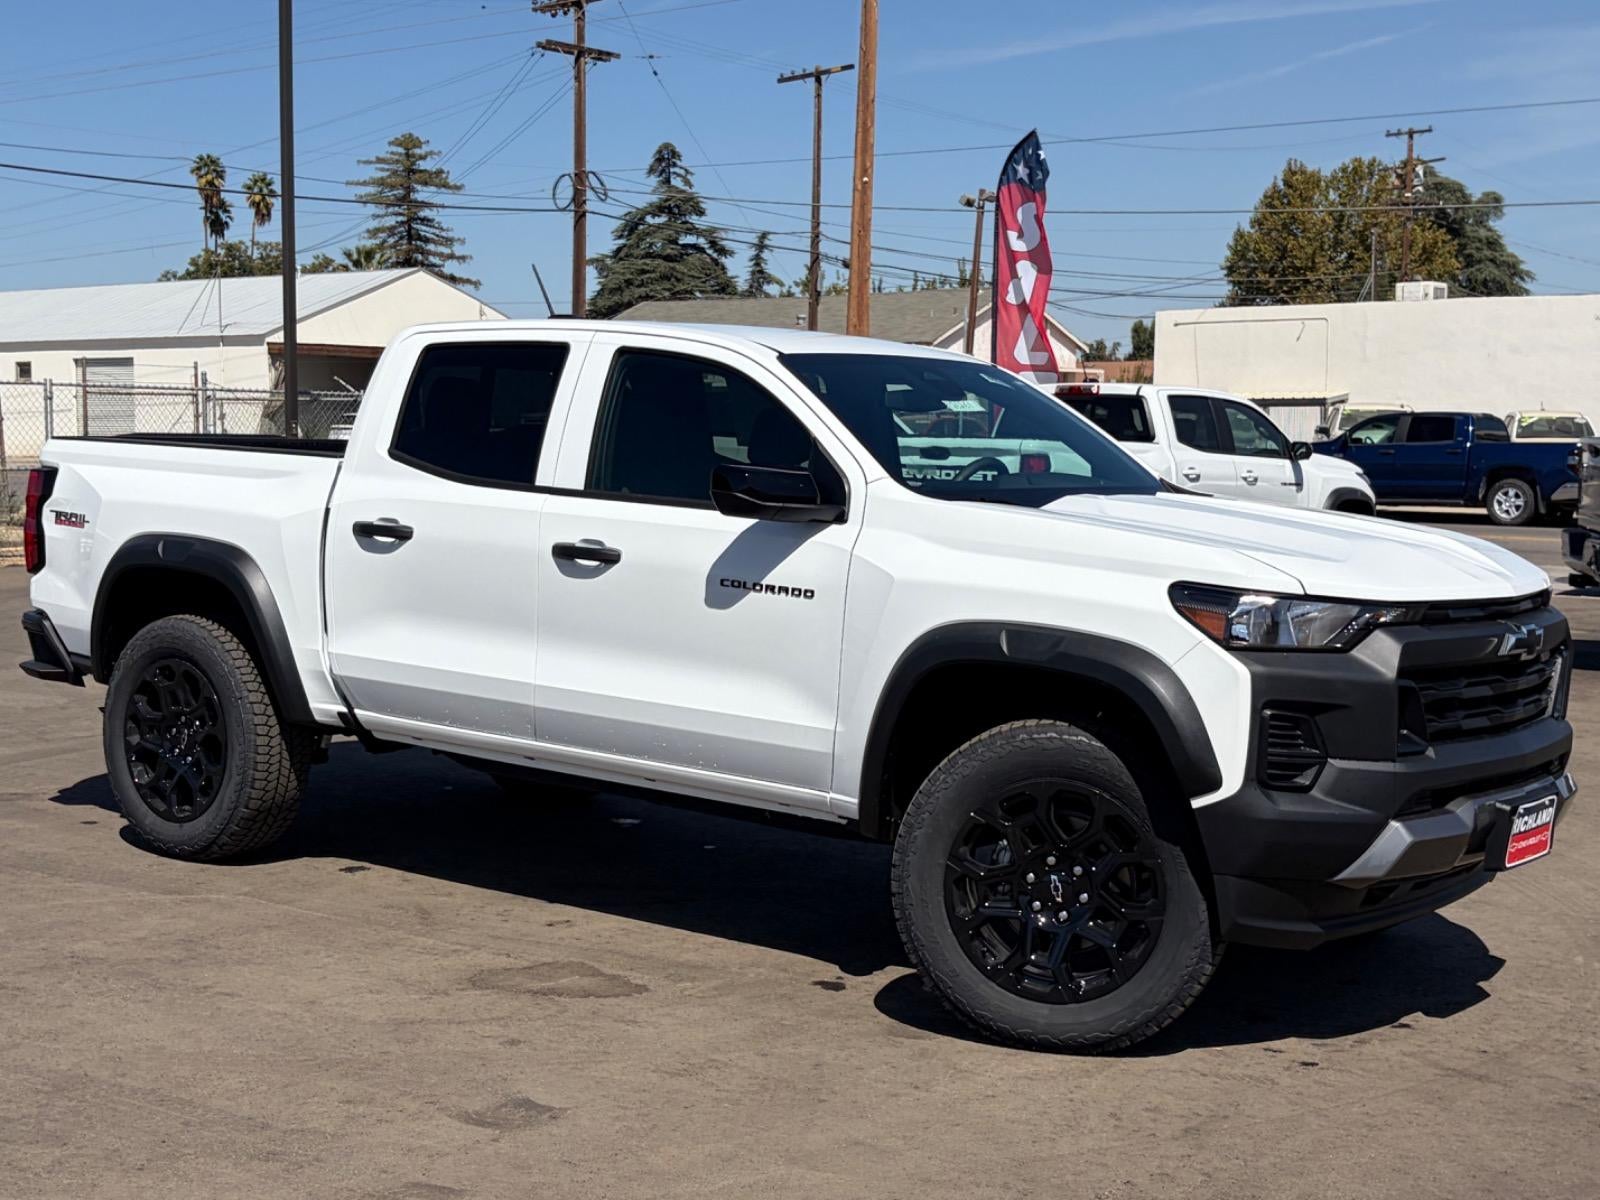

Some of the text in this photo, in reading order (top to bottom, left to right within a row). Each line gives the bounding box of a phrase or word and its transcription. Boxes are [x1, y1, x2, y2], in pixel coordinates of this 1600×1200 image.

[50, 510, 90, 524] TRAIL
[720, 578, 815, 600] COLORADO
[1511, 807, 1553, 834] RICHLAND
